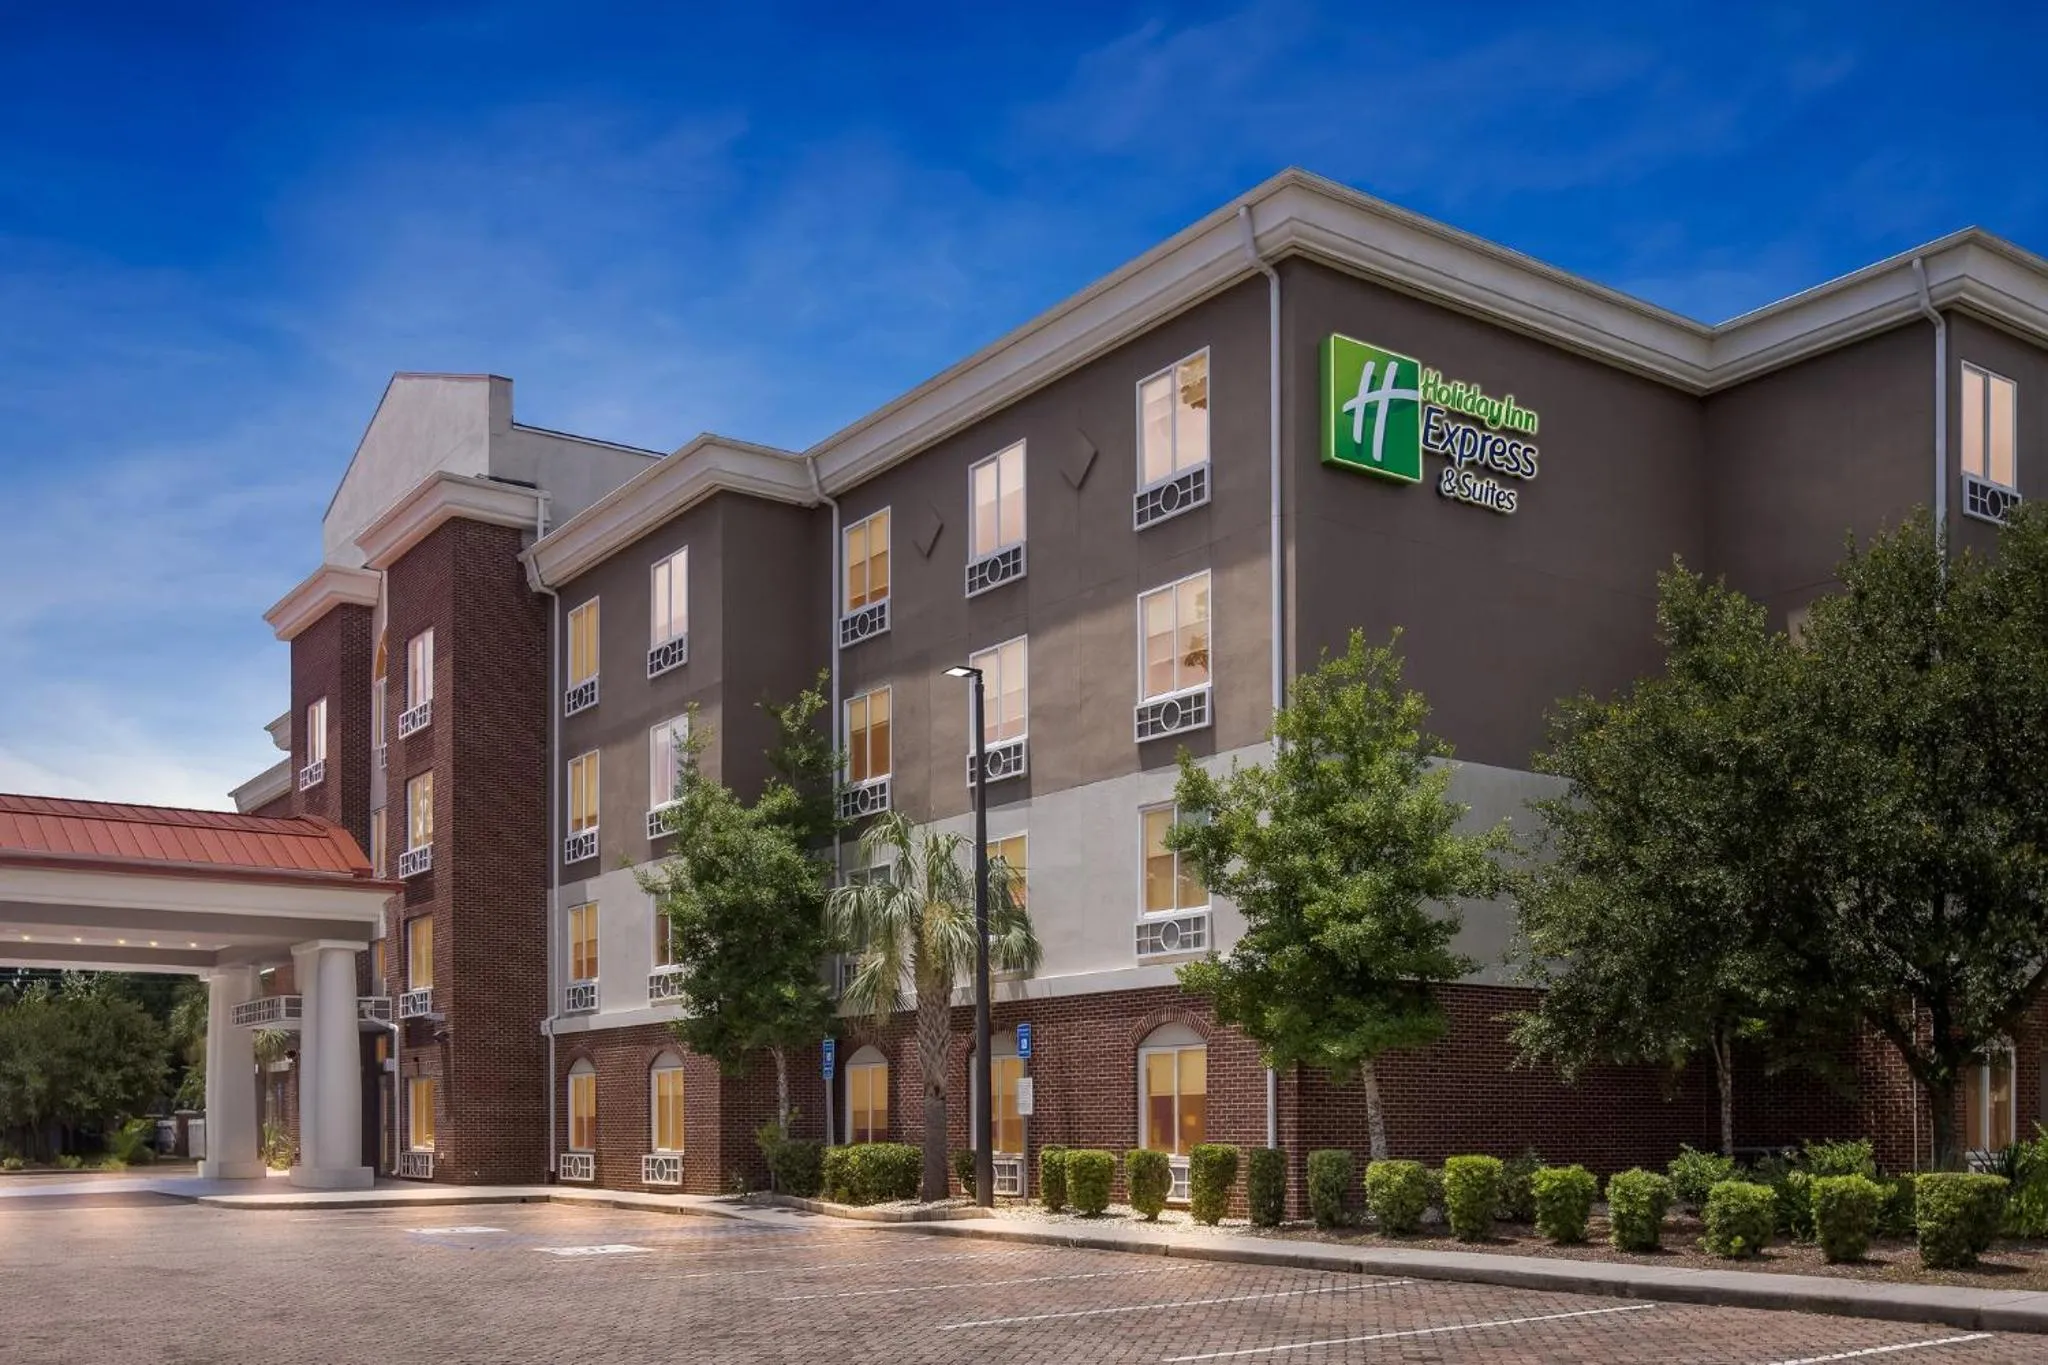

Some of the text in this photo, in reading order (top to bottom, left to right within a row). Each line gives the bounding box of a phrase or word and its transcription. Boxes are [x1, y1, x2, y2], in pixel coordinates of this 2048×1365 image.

[1342, 361, 1419, 462] H
[1421, 369, 1538, 432] Holiday Inn
[1422, 406, 1537, 477] Express
[1460, 473, 1516, 512] Suites
